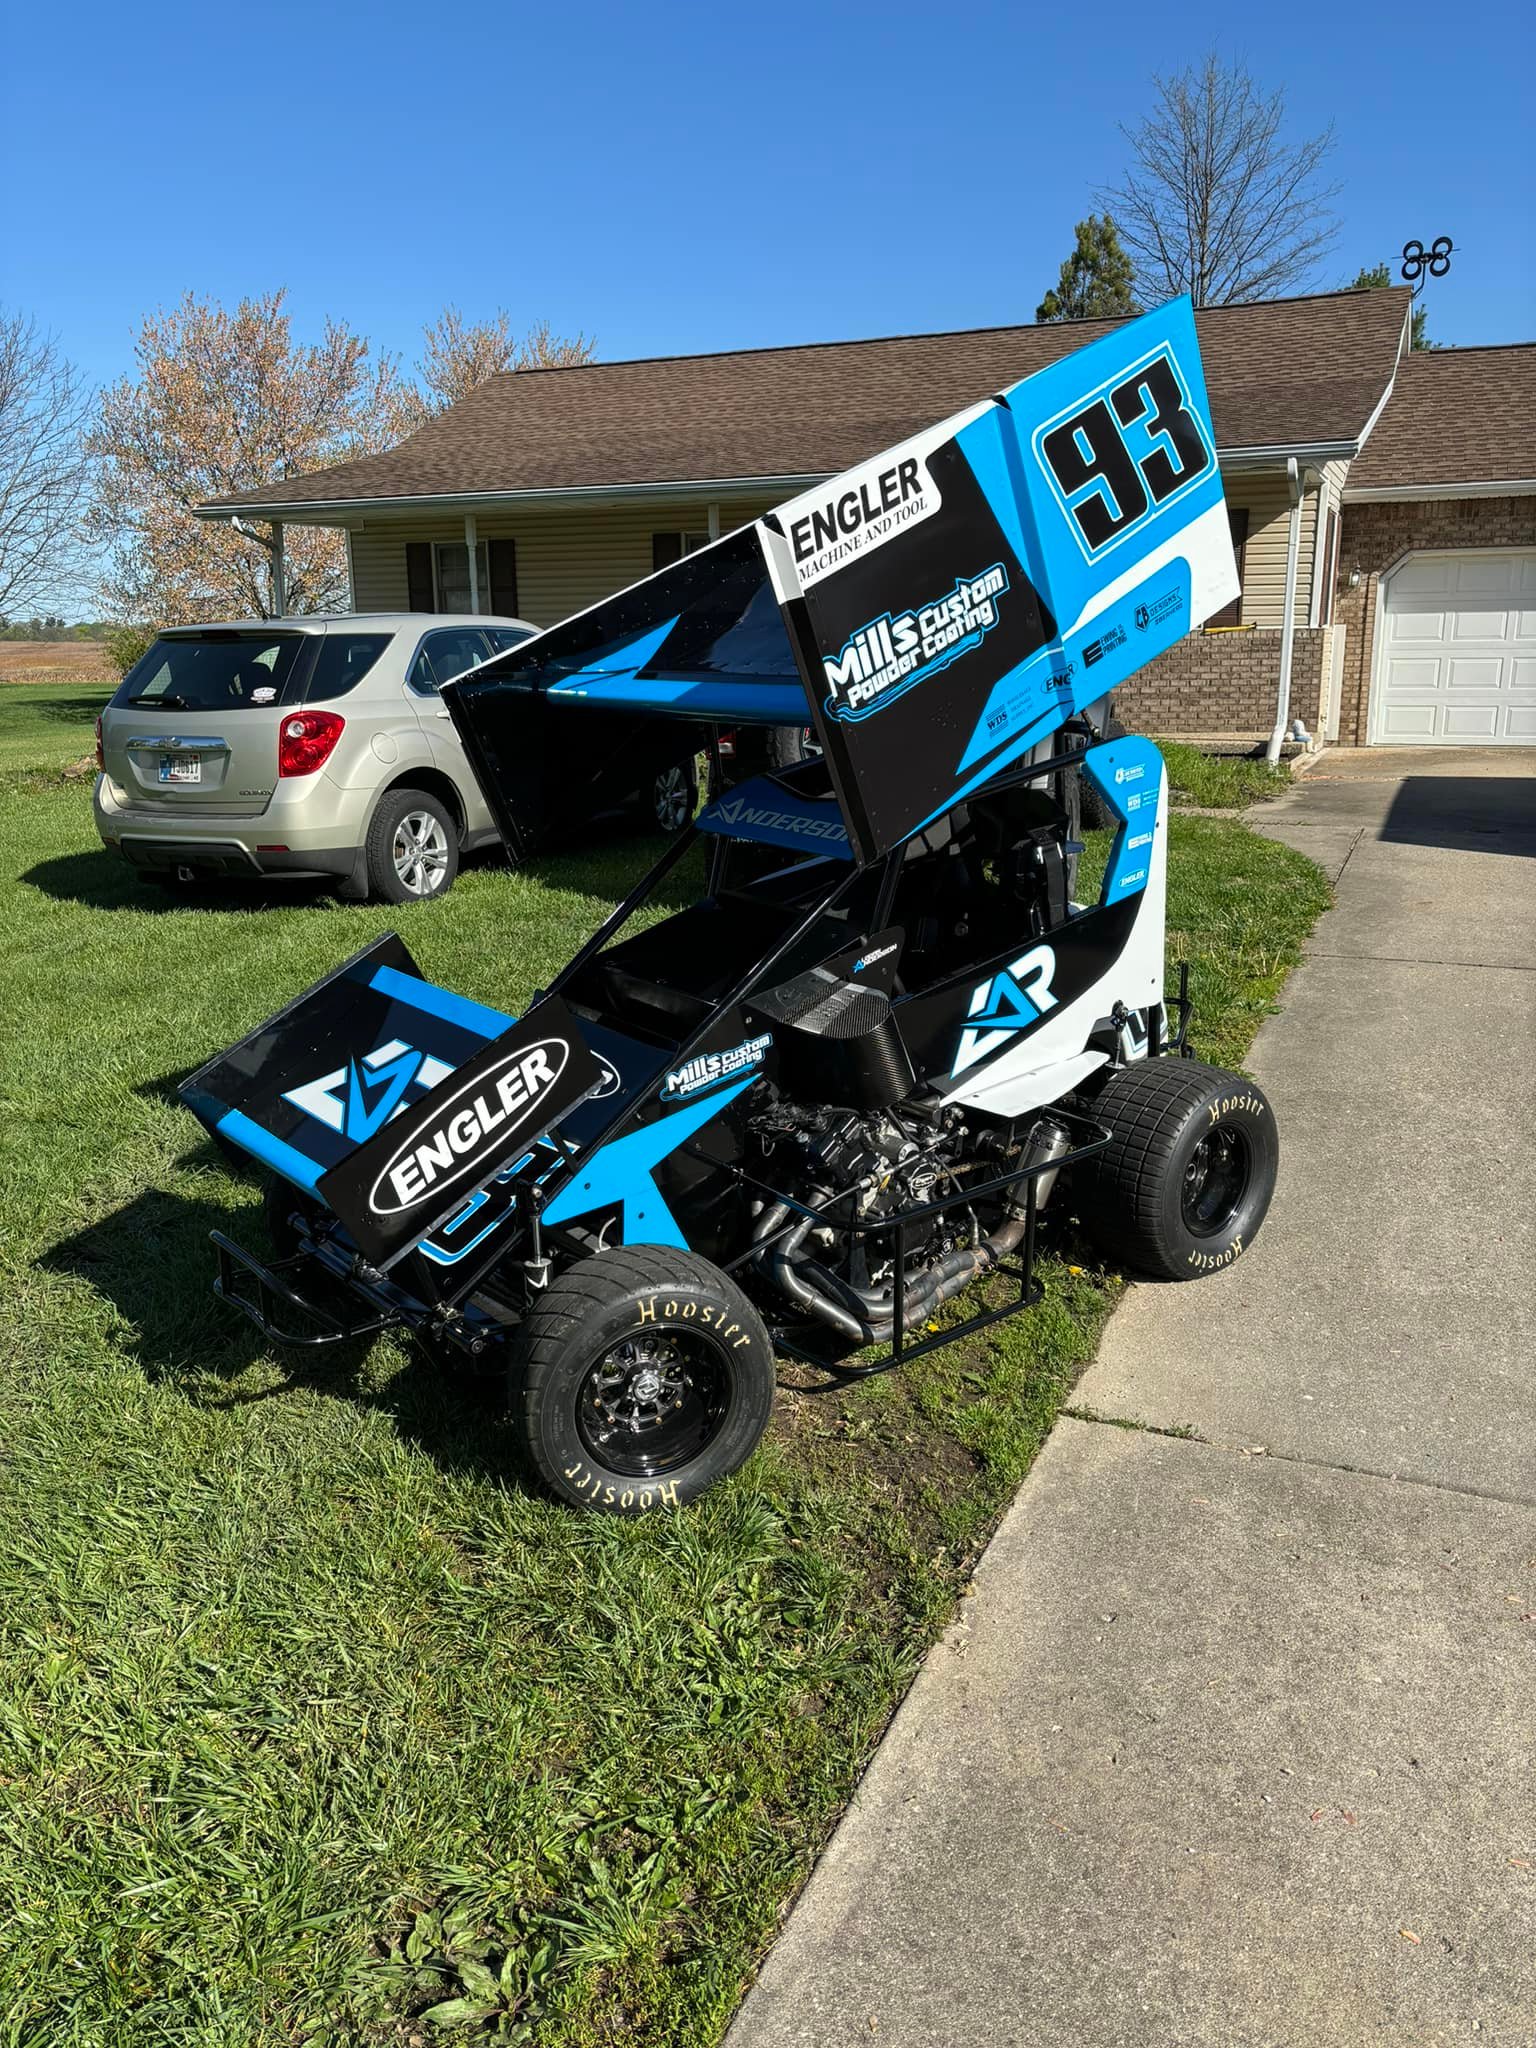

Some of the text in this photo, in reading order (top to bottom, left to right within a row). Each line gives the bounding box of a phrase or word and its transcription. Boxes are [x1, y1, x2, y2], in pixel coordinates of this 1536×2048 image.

[1043, 354, 1209, 551] 93
[790, 457, 923, 564] ENGLER
[799, 496, 928, 582] MACHINE AND TOOL
[823, 616, 919, 698] Mills
[987, 710, 1008, 731] WDS
[667, 1056, 722, 1092] Mills
[388, 1048, 556, 1206] ENGLER
[1208, 1091, 1265, 1127] Hoosier
[1187, 1234, 1244, 1273] Hoosier
[633, 1295, 751, 1348] Hoosier
[564, 1461, 683, 1509] Hoosier
